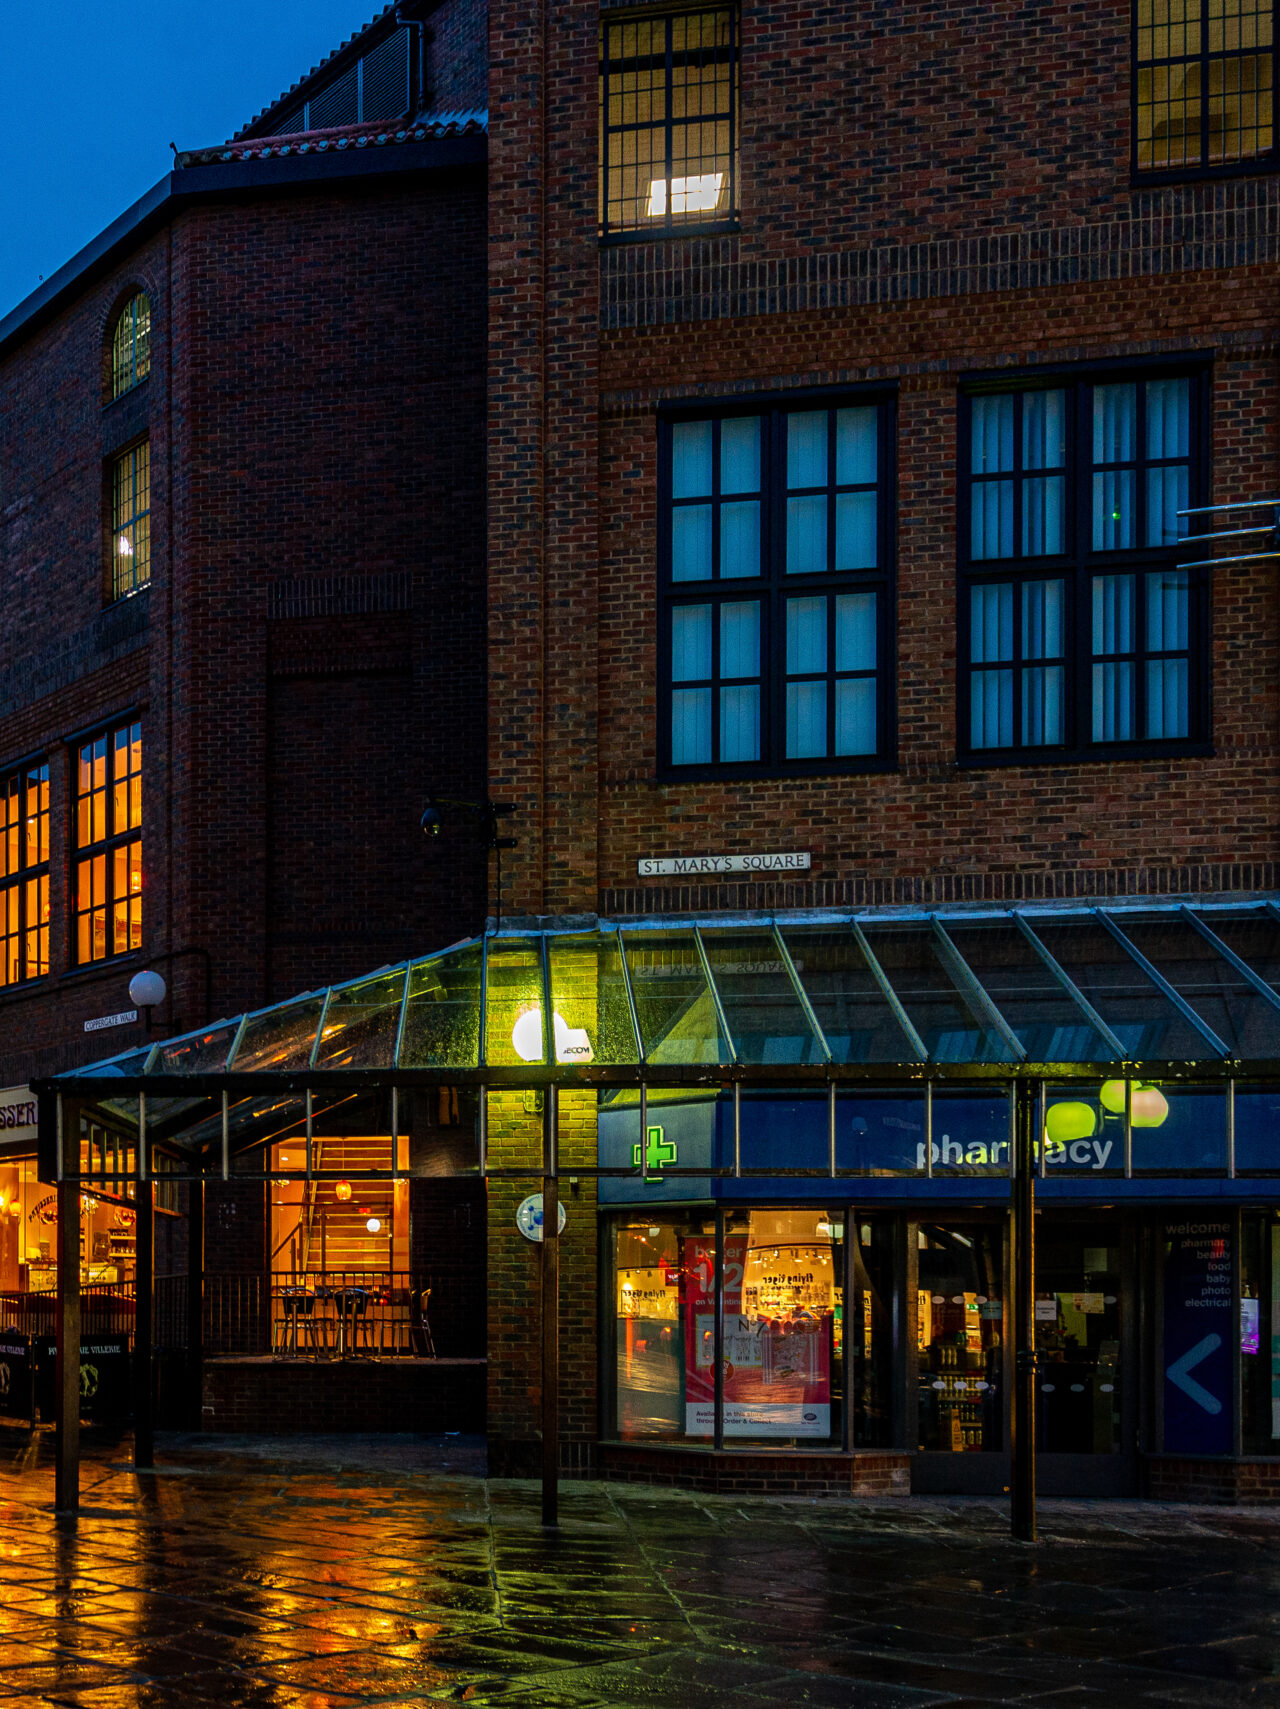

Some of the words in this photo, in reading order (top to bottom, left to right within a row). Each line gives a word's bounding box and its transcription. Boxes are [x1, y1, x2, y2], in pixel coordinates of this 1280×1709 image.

[644, 860, 666, 873] ST.
[673, 856, 732, 872] MARY'S
[742, 855, 805, 870] SQUARE
[916, 1134, 1113, 1169] pharacy
[1166, 1222, 1231, 1235] welcome
[1208, 1262, 1231, 1271] food
[1206, 1273, 1231, 1284] baby
[1201, 1285, 1231, 1296] photo
[1185, 1298, 1231, 1308] electrical
